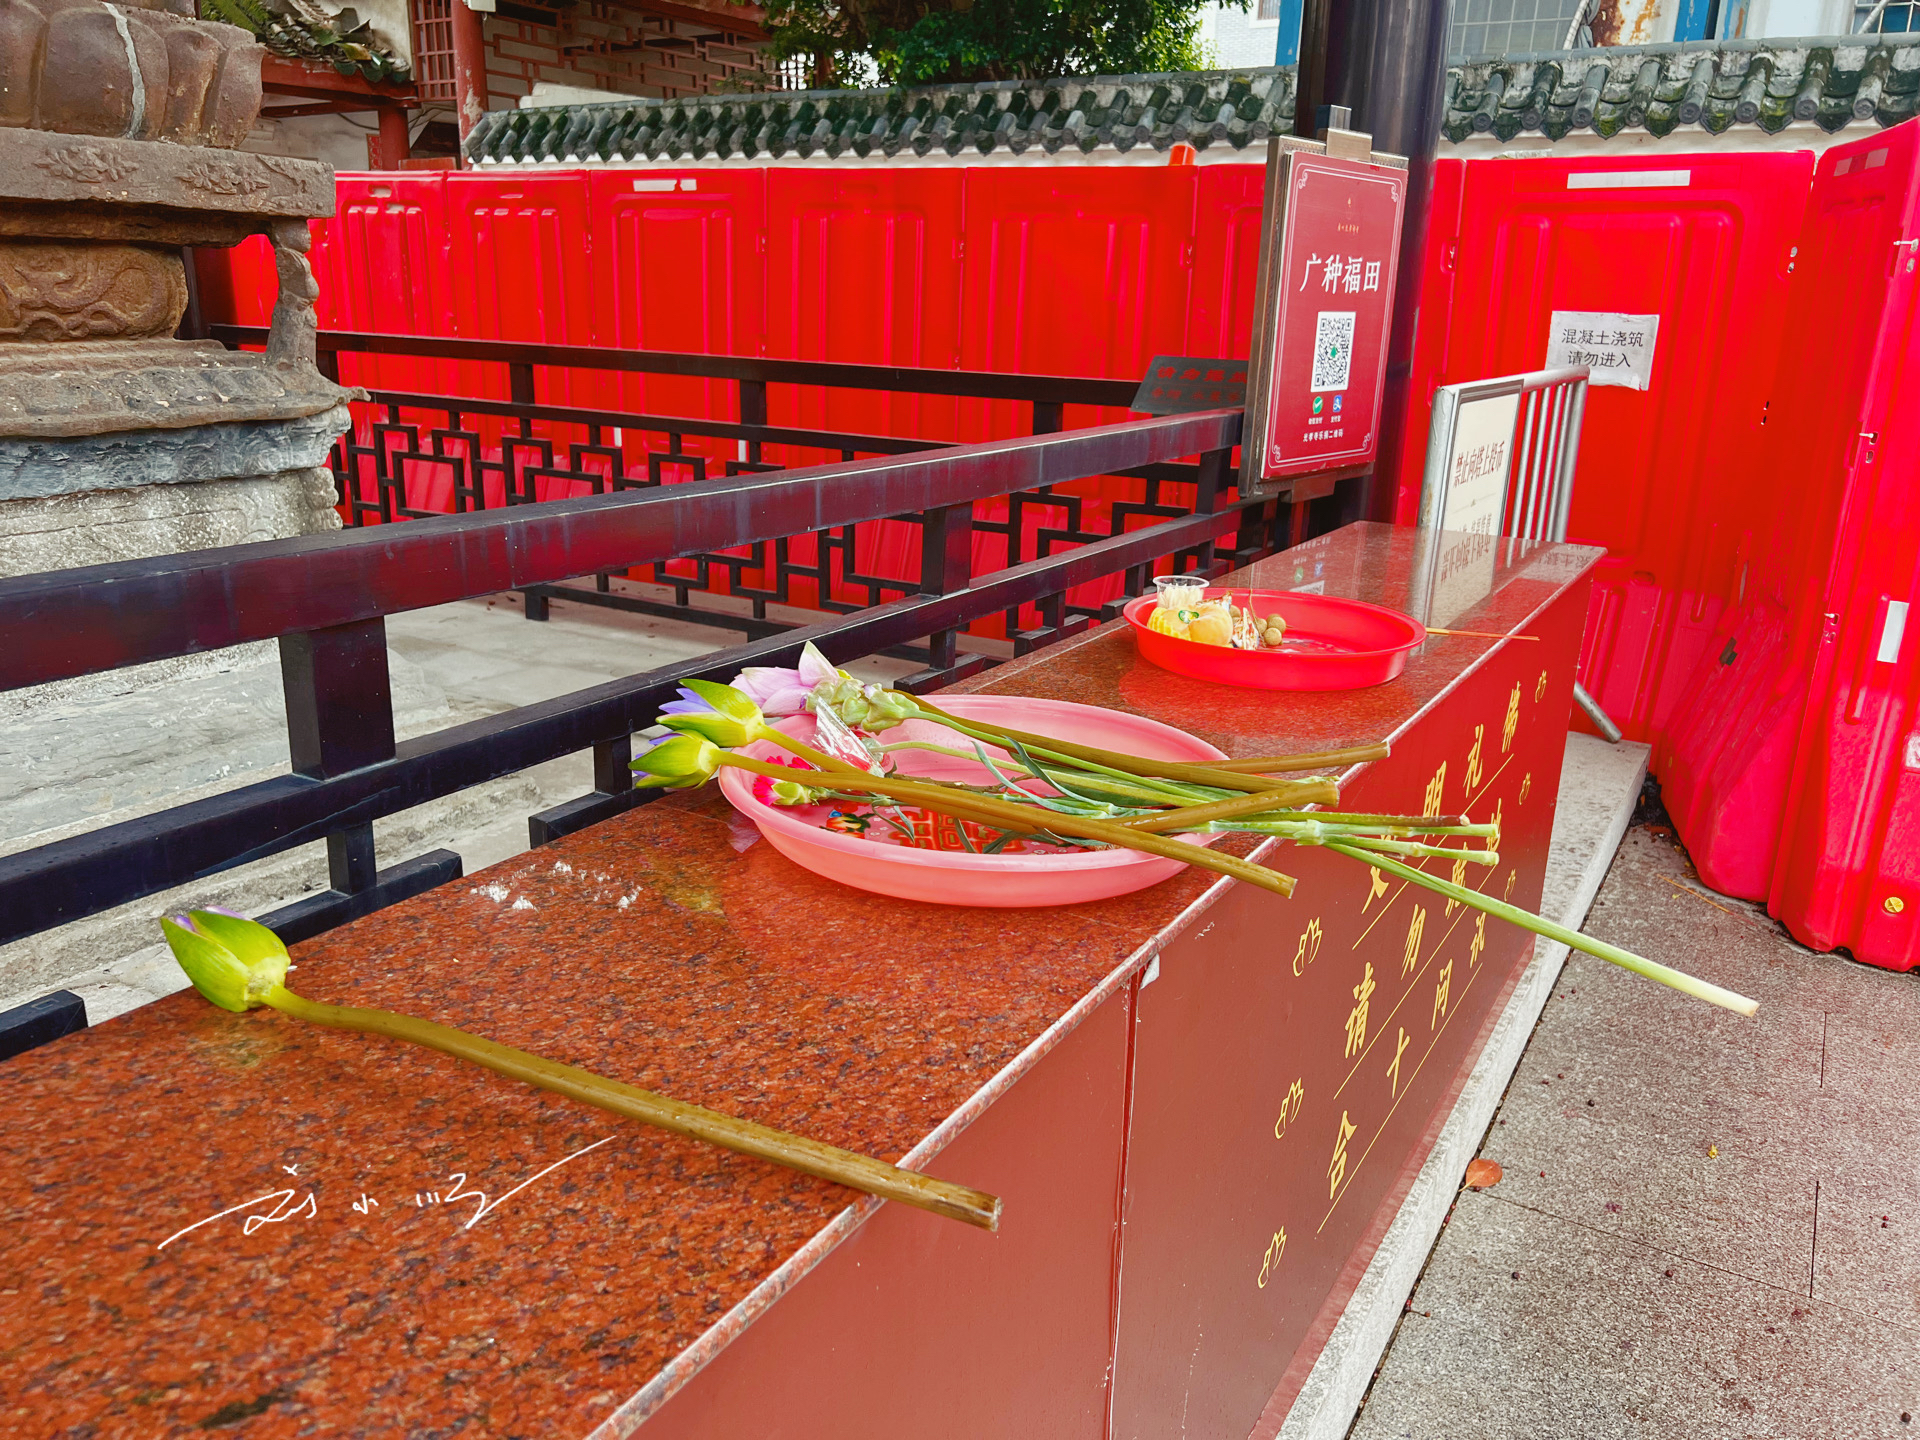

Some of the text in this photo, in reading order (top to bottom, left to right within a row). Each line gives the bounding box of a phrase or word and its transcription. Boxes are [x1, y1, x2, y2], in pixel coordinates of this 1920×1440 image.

[1300, 253, 1381, 294] 广种福田
[1560, 328, 1644, 348] 混凝土浇筑
[1567, 351, 1631, 368] 请勿进入
[1452, 440, 1505, 489] 禁止向塔上投币
[1326, 912, 1486, 1200] 合十问讯
